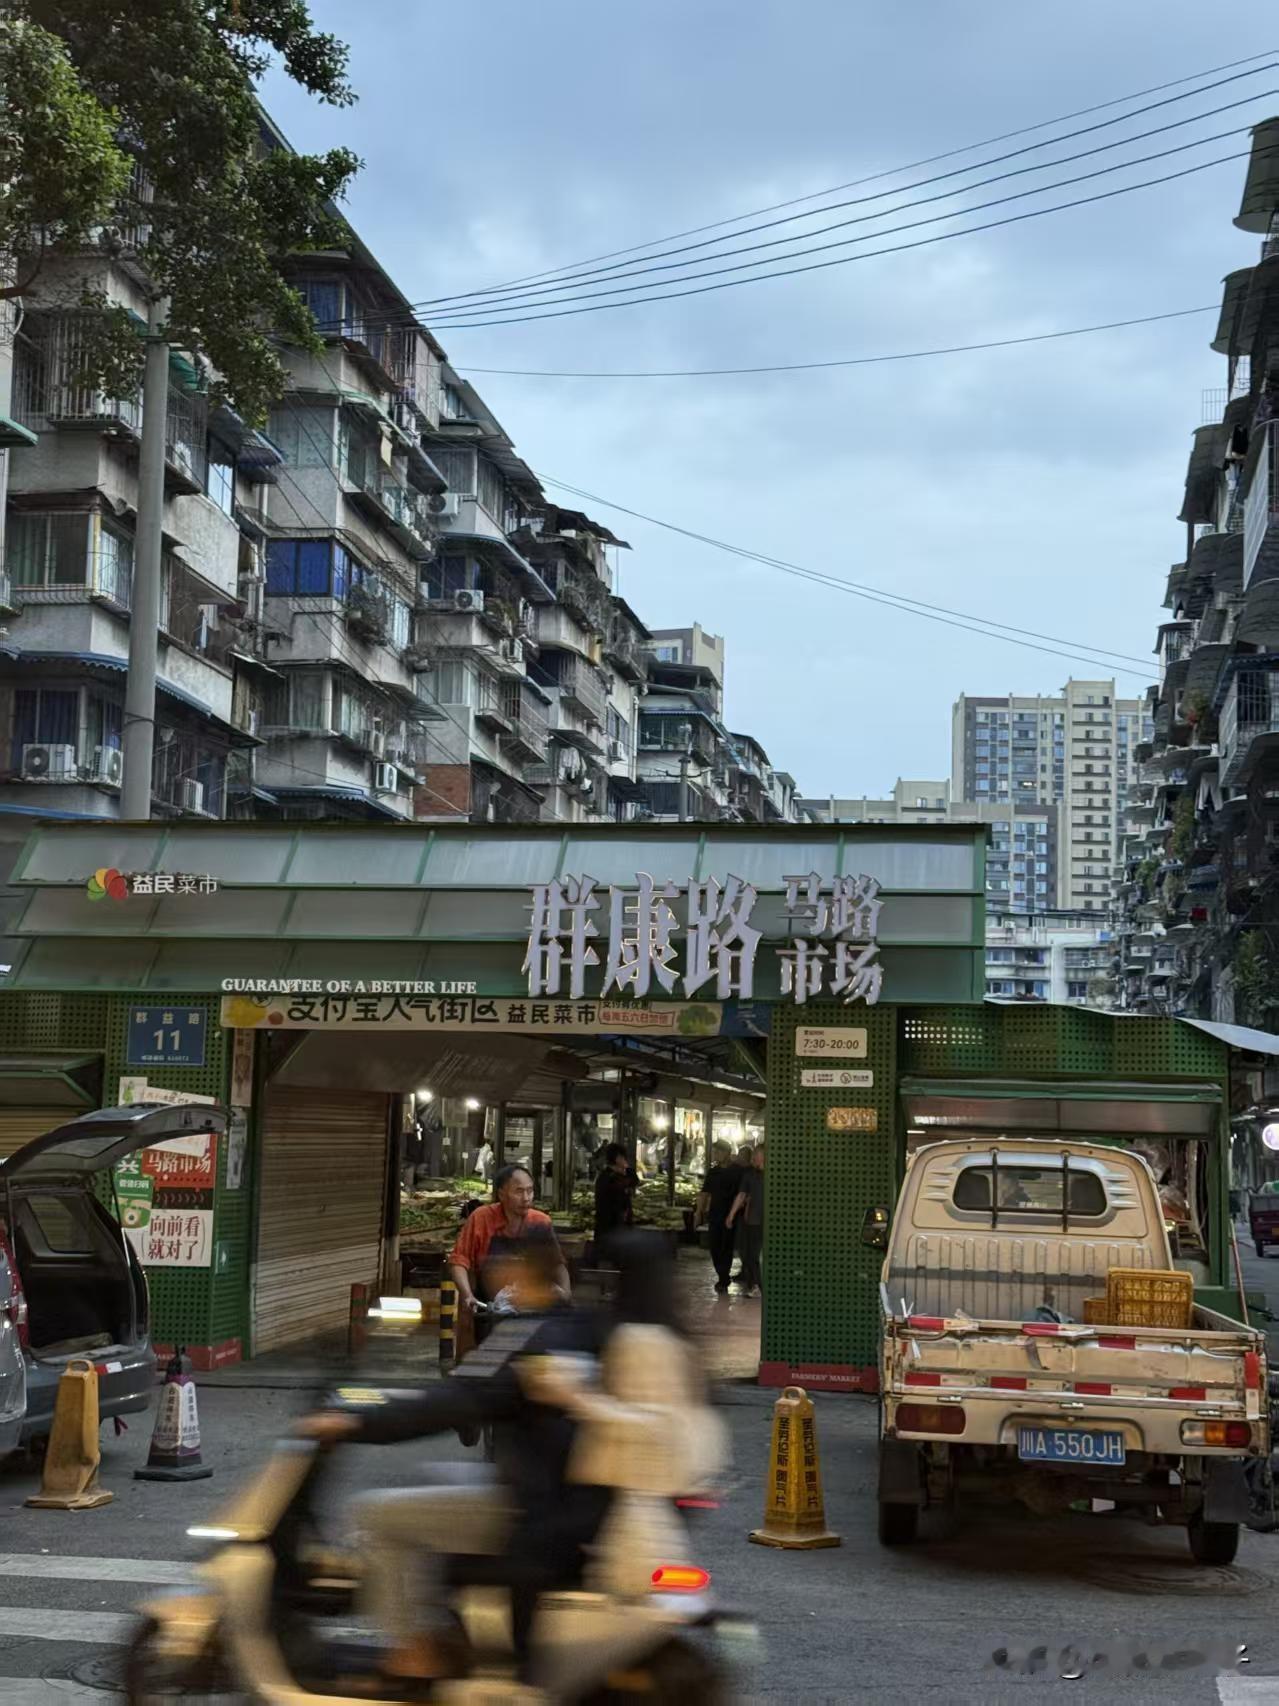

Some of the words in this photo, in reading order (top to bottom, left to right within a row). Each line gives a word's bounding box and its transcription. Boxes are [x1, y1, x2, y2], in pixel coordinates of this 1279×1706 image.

[132, 873, 219, 895] 益民菜市
[776, 872, 884, 938] 马路
[521, 872, 763, 999] 群康路
[776, 938, 883, 1005] 市场
[221, 978, 323, 994] GUARANTEE
[326, 980, 350, 993] OF
[354, 980, 367, 993] A
[371, 980, 436, 994] BETTER
[440, 981, 477, 993] LIFE
[508, 1003, 596, 1025] 益民菜市
[153, 1029, 181, 1051] 11
[803, 1039, 860, 1050] 7:30-20:00
[149, 1215, 201, 1238] 向前看
[147, 1239, 199, 1261] 就对了
[1021, 1431, 1047, 1455] 川A
[1054, 1432, 1122, 1459] 550JH
